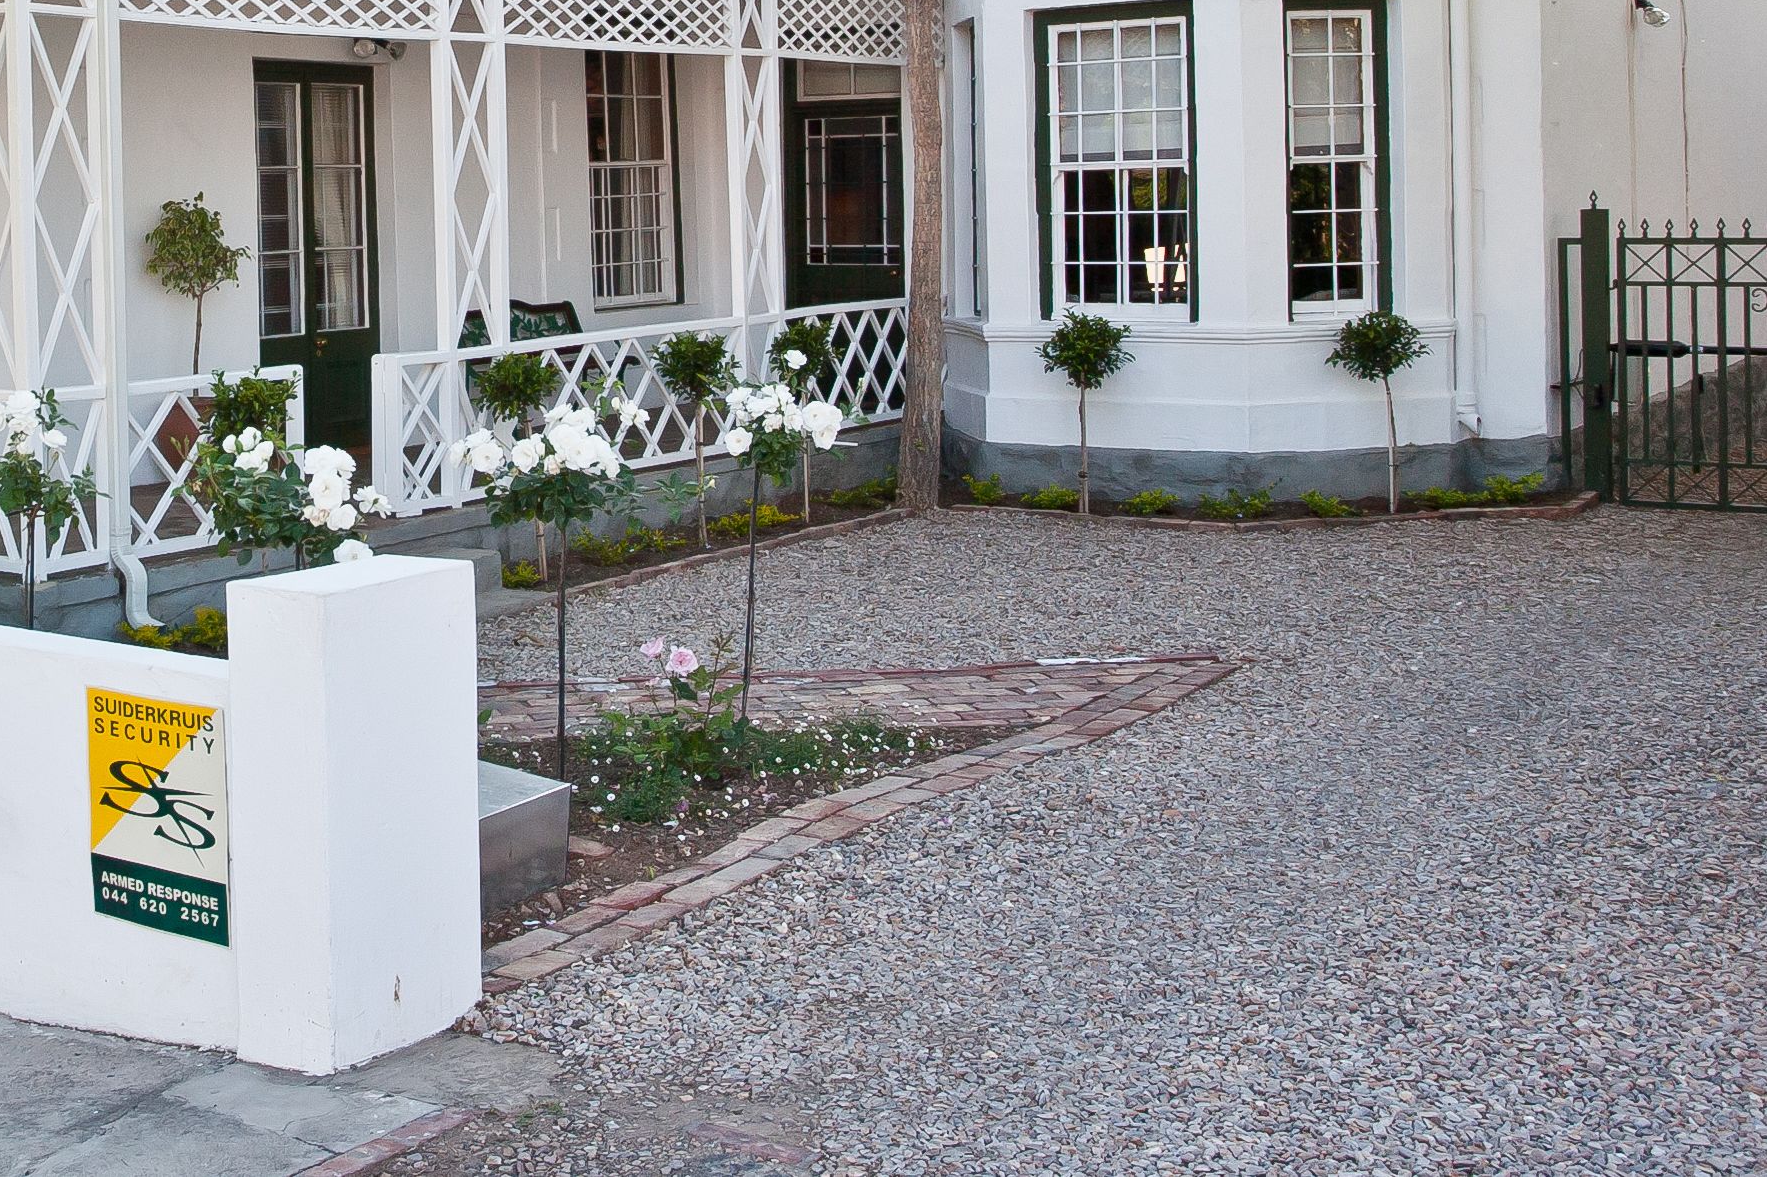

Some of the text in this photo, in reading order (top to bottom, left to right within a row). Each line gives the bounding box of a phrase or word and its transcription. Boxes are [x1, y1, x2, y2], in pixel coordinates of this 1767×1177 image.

[94, 696, 214, 732] SUIDERKRUIS
[95, 718, 214, 754] SECURITY
[101, 871, 219, 911] ARMED RESPONSE
[102, 887, 219, 927] 044 620 2567
